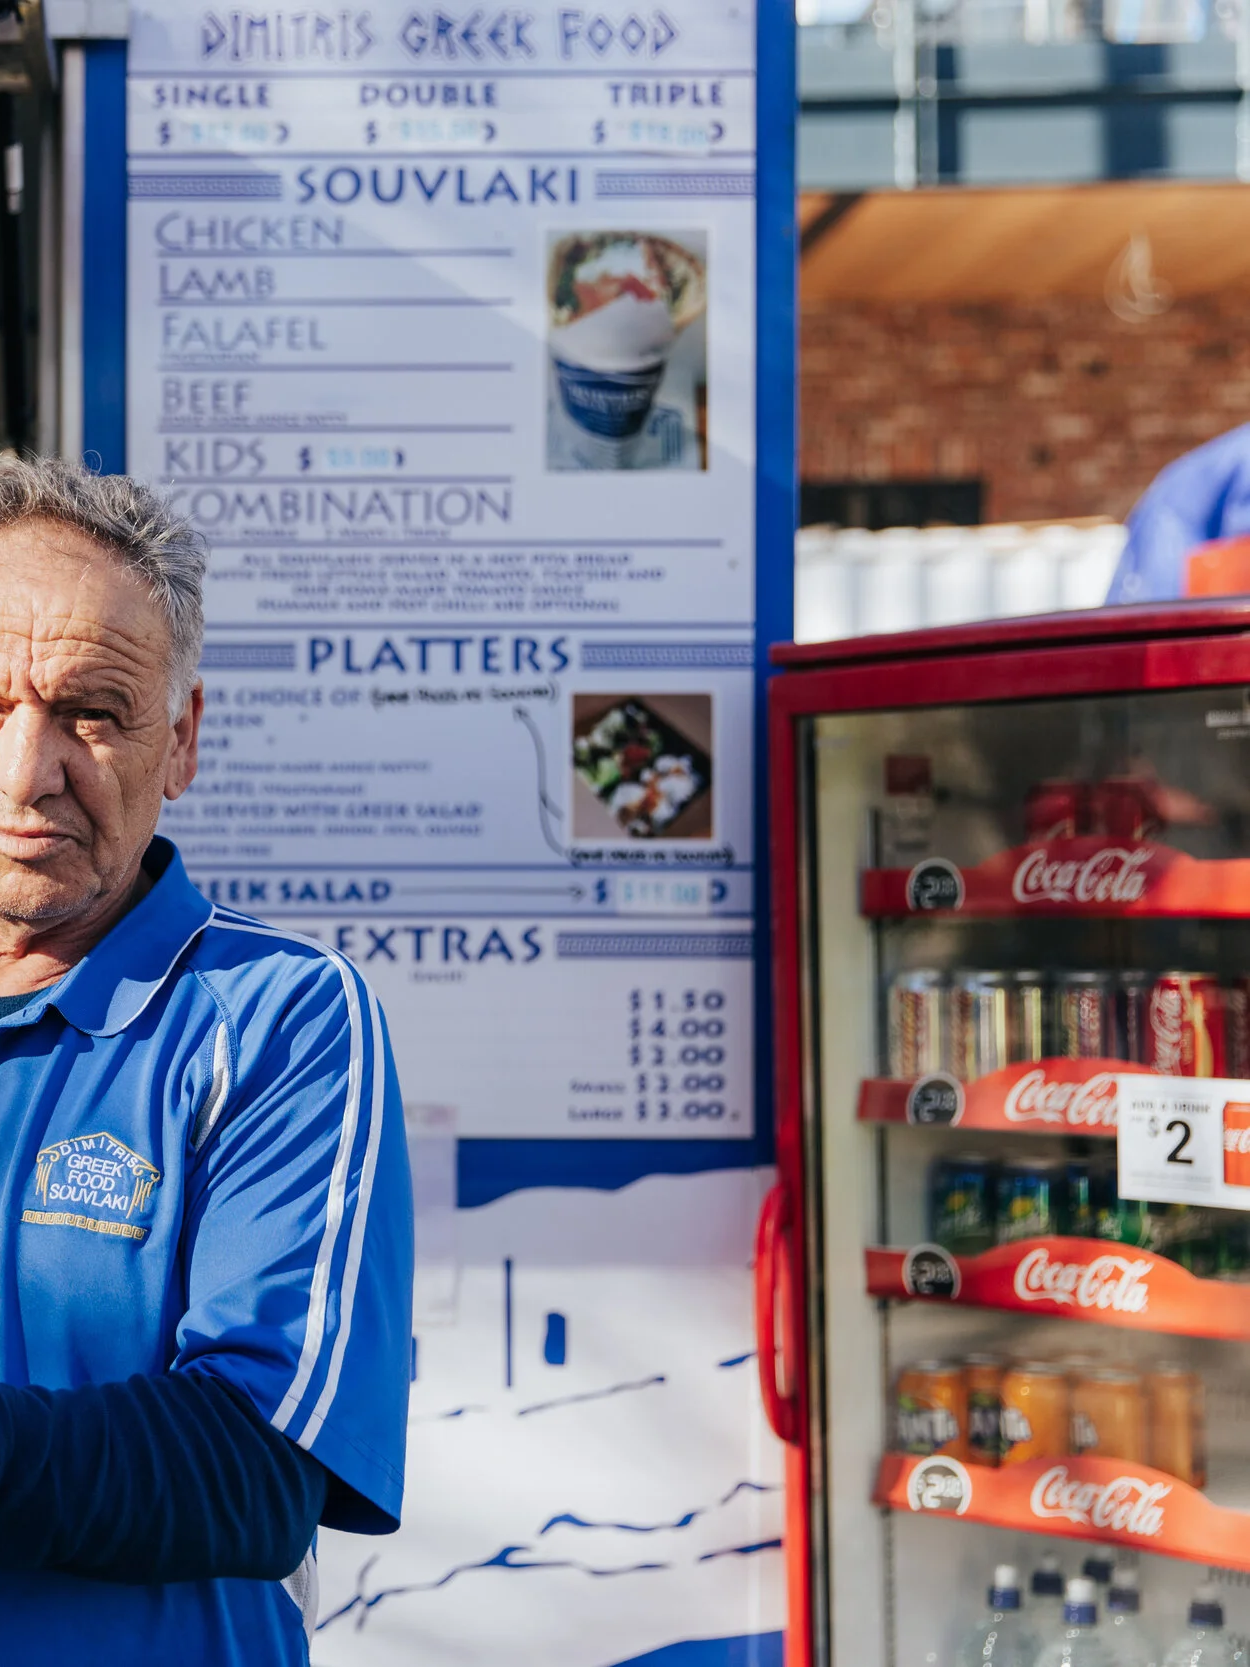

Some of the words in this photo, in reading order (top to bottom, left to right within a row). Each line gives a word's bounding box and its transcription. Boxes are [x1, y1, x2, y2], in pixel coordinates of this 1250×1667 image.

[202, 10, 373, 60] DIMITRIS
[400, 10, 536, 60] GREEK
[558, 10, 679, 60] FOOD
[153, 83, 269, 107] SINGLE
[359, 82, 497, 107] DOUBLE
[608, 81, 723, 106] TRIPLE
[296, 166, 579, 206] SOUVLAKI
[154, 211, 345, 253] CHICKEN
[158, 263, 276, 300] LAMB
[162, 312, 328, 352] FALAFEL
[162, 377, 252, 414] BEEF
[163, 436, 267, 476] KIDS
[307, 635, 570, 674] PLATTERS
[234, 686, 322, 706] CHOICE
[279, 880, 392, 905] SALAD
[336, 924, 543, 962] EXTRAS
[59, 1136, 138, 1169] DIMITRIS
[67, 1153, 125, 1178] GREEK
[49, 1183, 129, 1211] SOUVLAKI
[67, 1169, 116, 1192] FOOD
